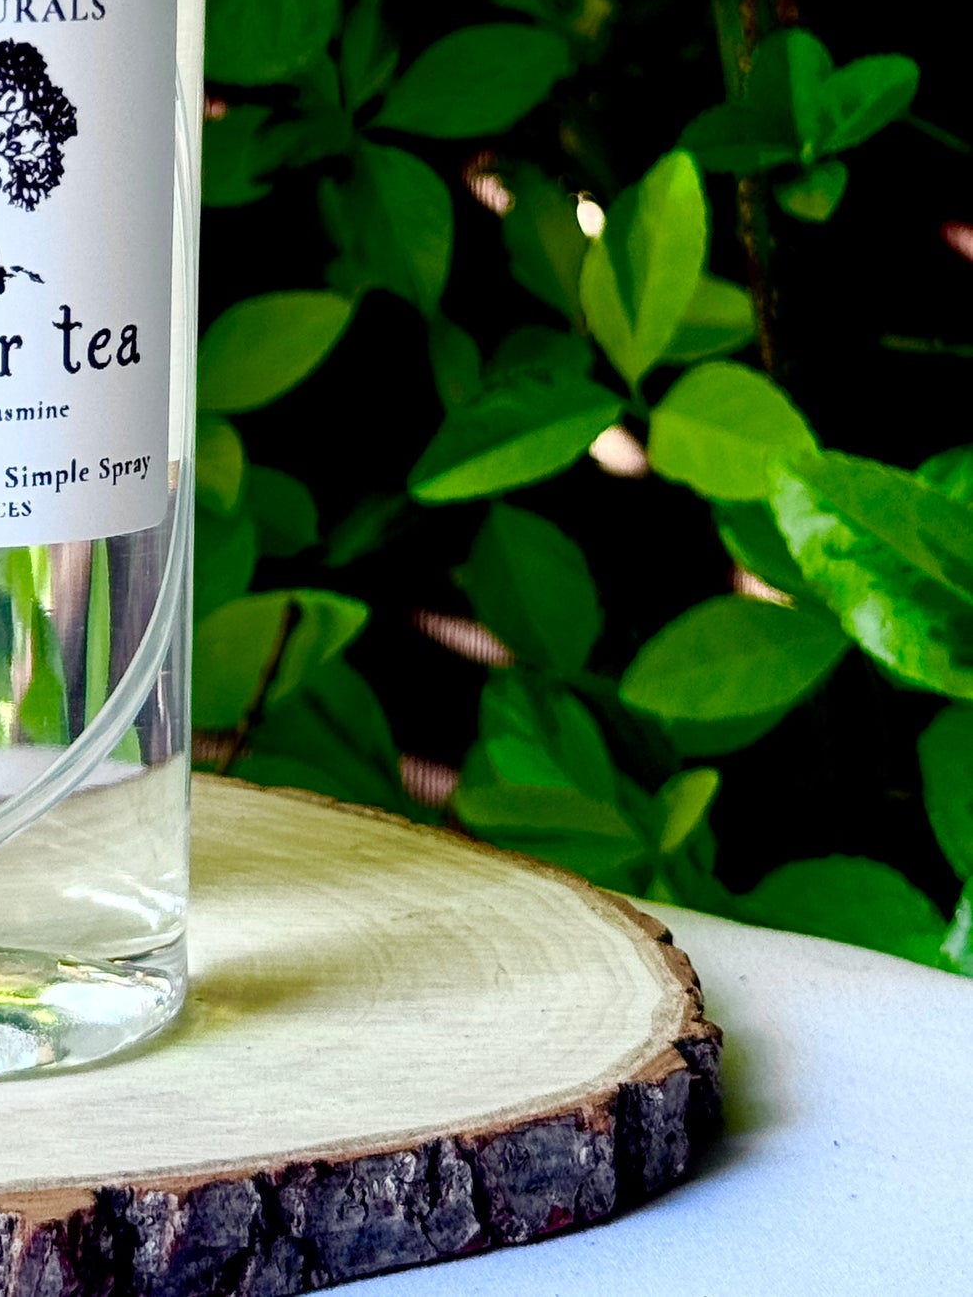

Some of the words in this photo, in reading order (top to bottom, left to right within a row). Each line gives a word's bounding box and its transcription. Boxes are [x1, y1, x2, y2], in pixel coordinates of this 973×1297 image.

[51, 303, 141, 375] tea
[4, 456, 90, 494] Simple
[98, 451, 151, 486] Spray
